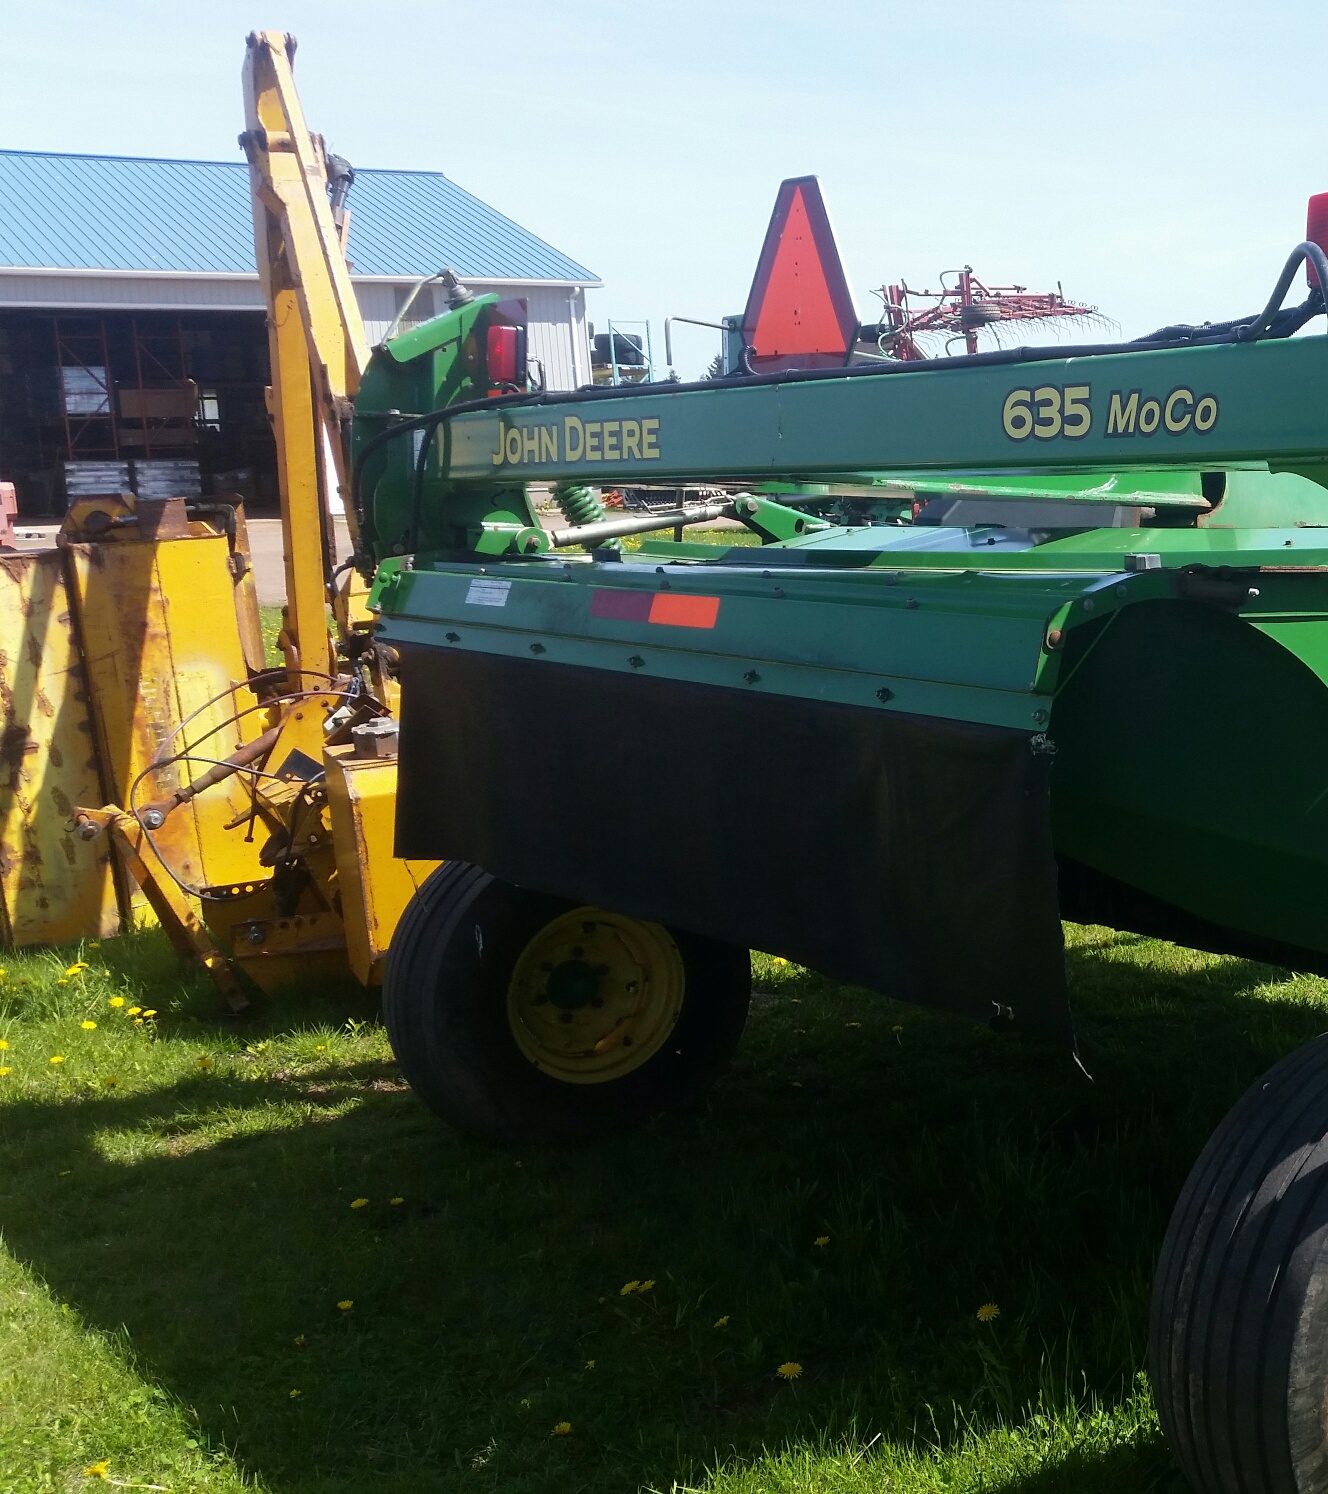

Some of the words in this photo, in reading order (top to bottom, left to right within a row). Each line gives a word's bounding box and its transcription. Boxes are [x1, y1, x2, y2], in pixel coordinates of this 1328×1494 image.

[1002, 385, 1092, 439] 635
[1106, 389, 1218, 434] MoCo
[492, 421, 558, 466] JOHN
[564, 416, 660, 463] DEERE
